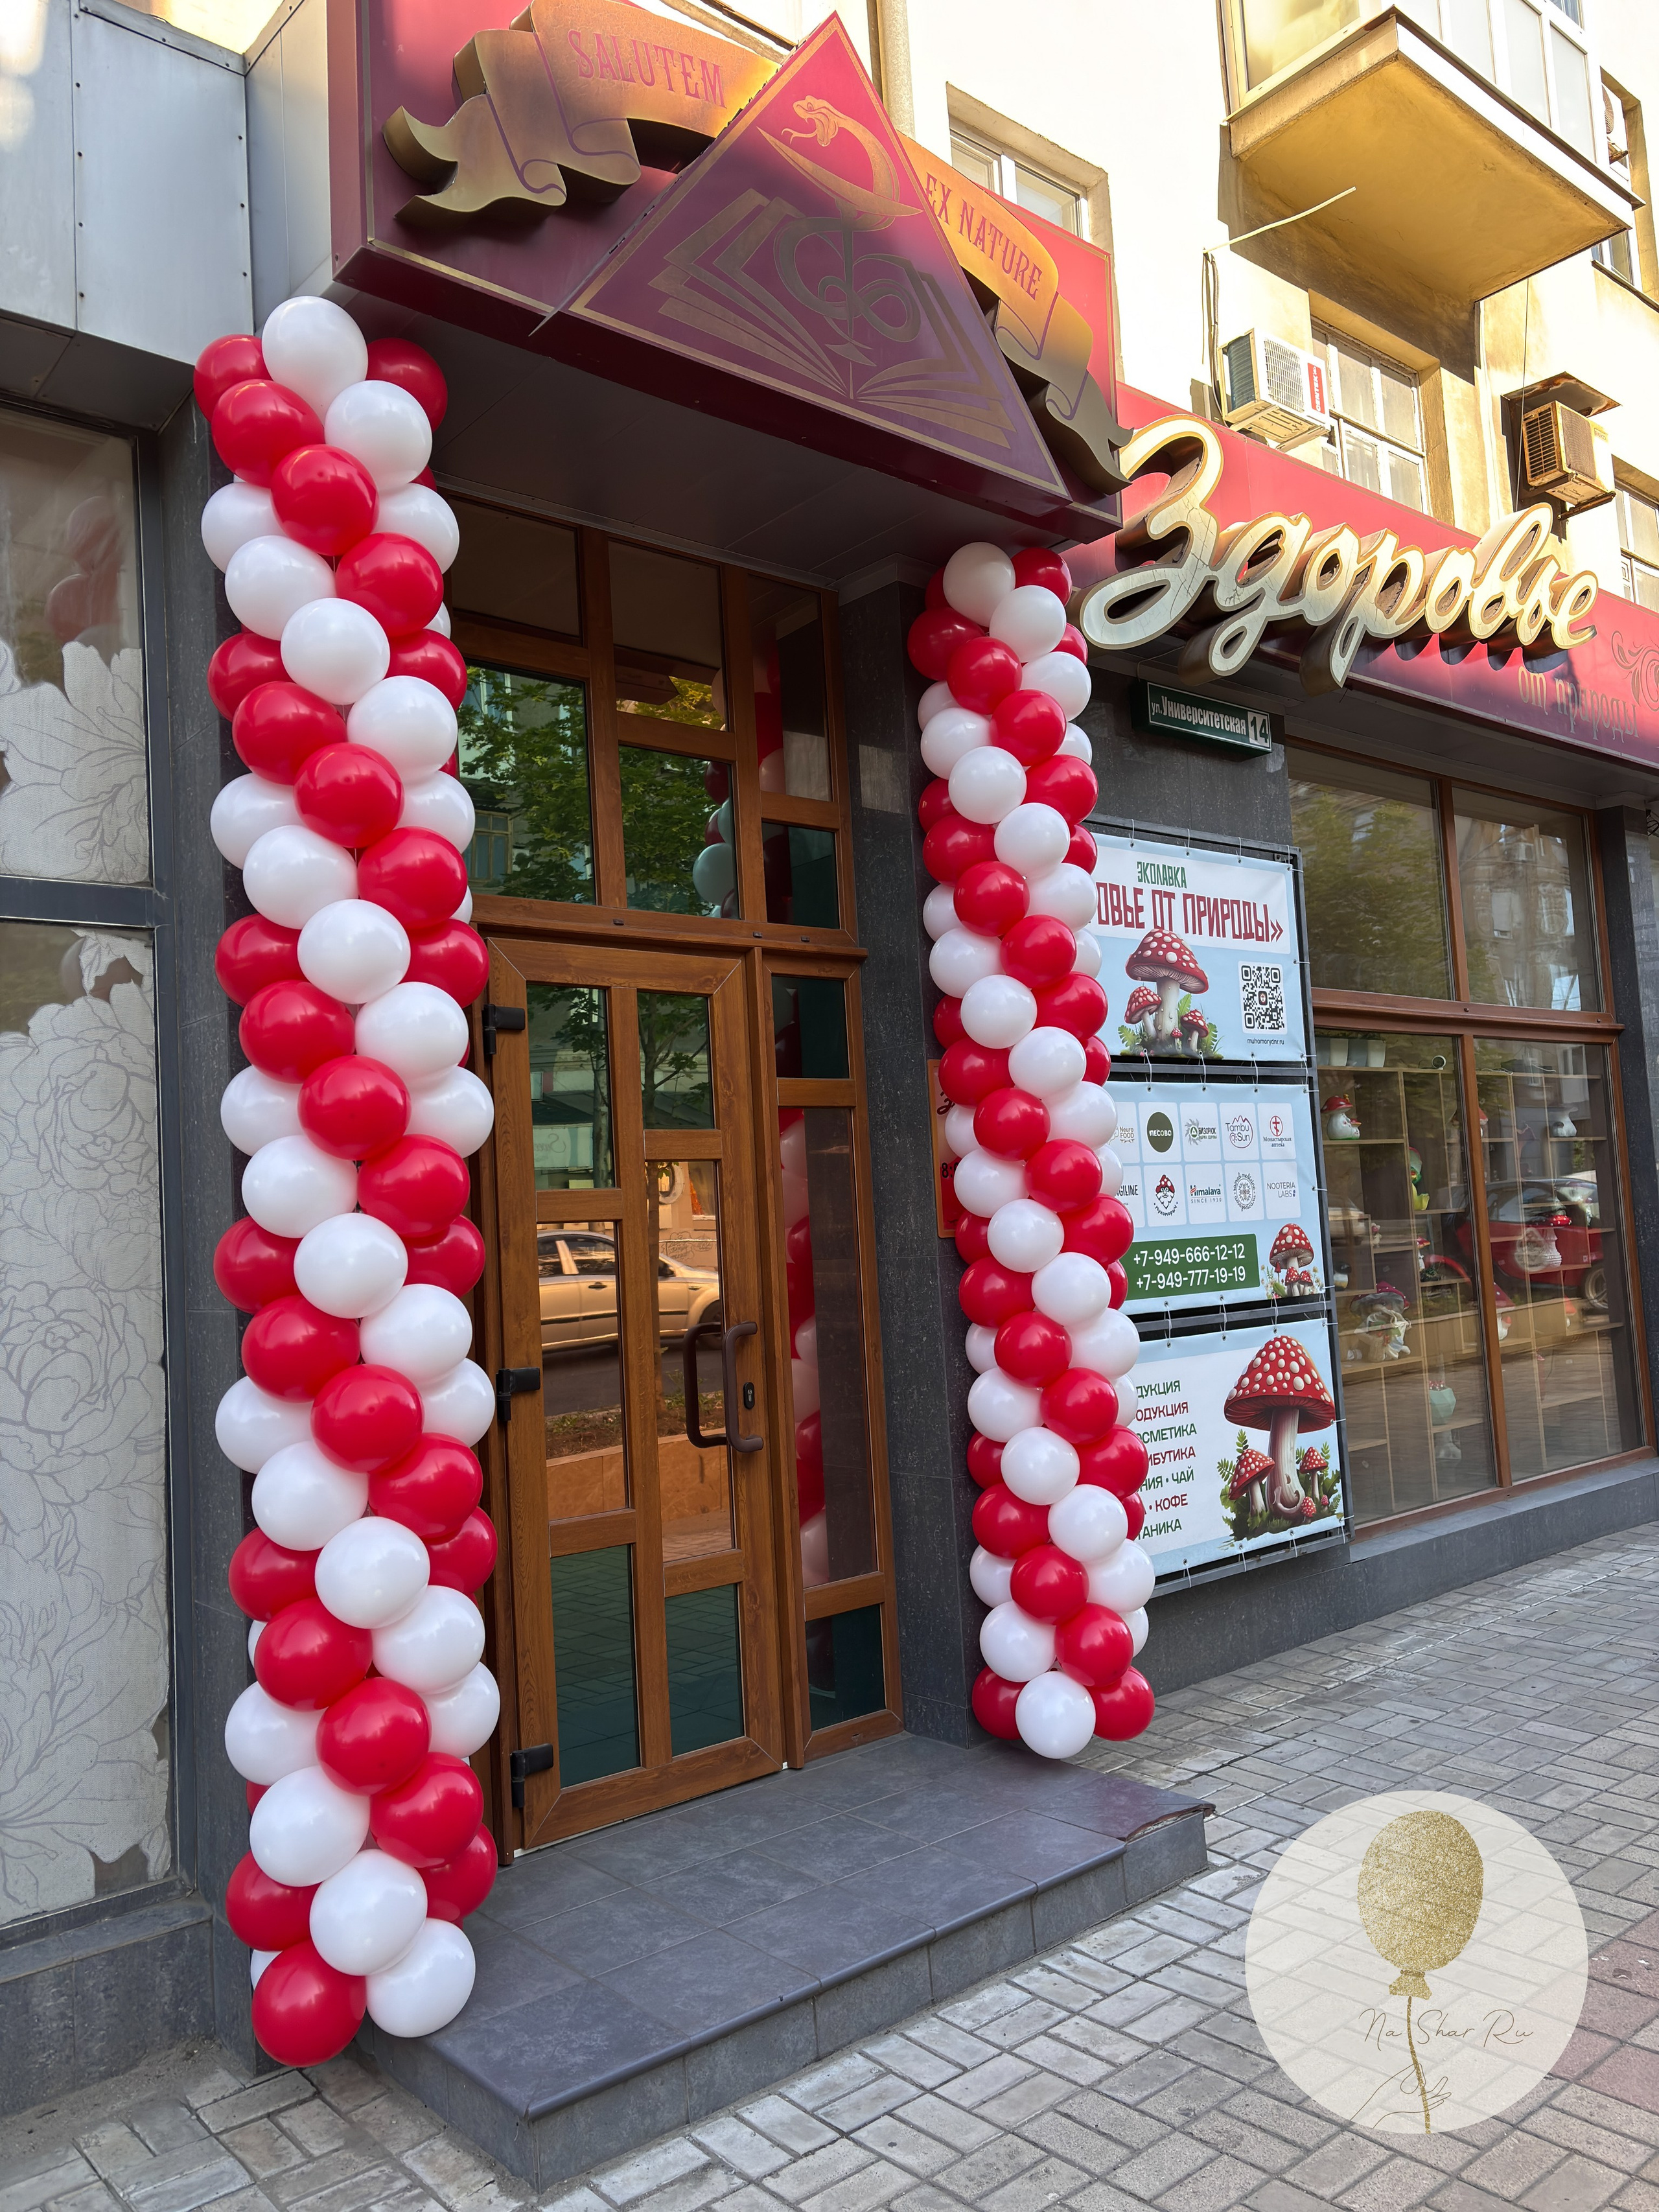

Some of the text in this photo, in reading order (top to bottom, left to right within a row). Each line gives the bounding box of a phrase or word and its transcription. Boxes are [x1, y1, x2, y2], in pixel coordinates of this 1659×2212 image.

[568, 30, 726, 109] SALUTEM
[925, 172, 1042, 300] EX NATURE
[1078, 413, 1598, 689] Здоровье
[1518, 666, 1639, 743] от природы
[1161, 696, 1247, 736] Университетская
[1250, 716, 1268, 743] 14
[1137, 861, 1187, 889] ЭКОЛАВКА
[1095, 881, 1145, 929] ОВЬЕ
[1152, 889, 1176, 932] ОТ
[1225, 1123, 1249, 1132] Tambu
[1117, 1185, 1139, 1196] GILINE
[1190, 1185, 1221, 1196] Himalaya
[1133, 1242, 1246, 1267] +7-949-666-12-12
[1136, 1265, 1246, 1291] +7-949-777-19-19
[1136, 1380, 1181, 1399] ДУКЦИЯ
[1135, 1401, 1189, 1422] ОДУКЦИЯ
[1148, 1446, 1196, 1466] ИБУТИКА
[1171, 1465, 1194, 1484] ЧАЙ
[1155, 1493, 1189, 1513] КОФЕ
